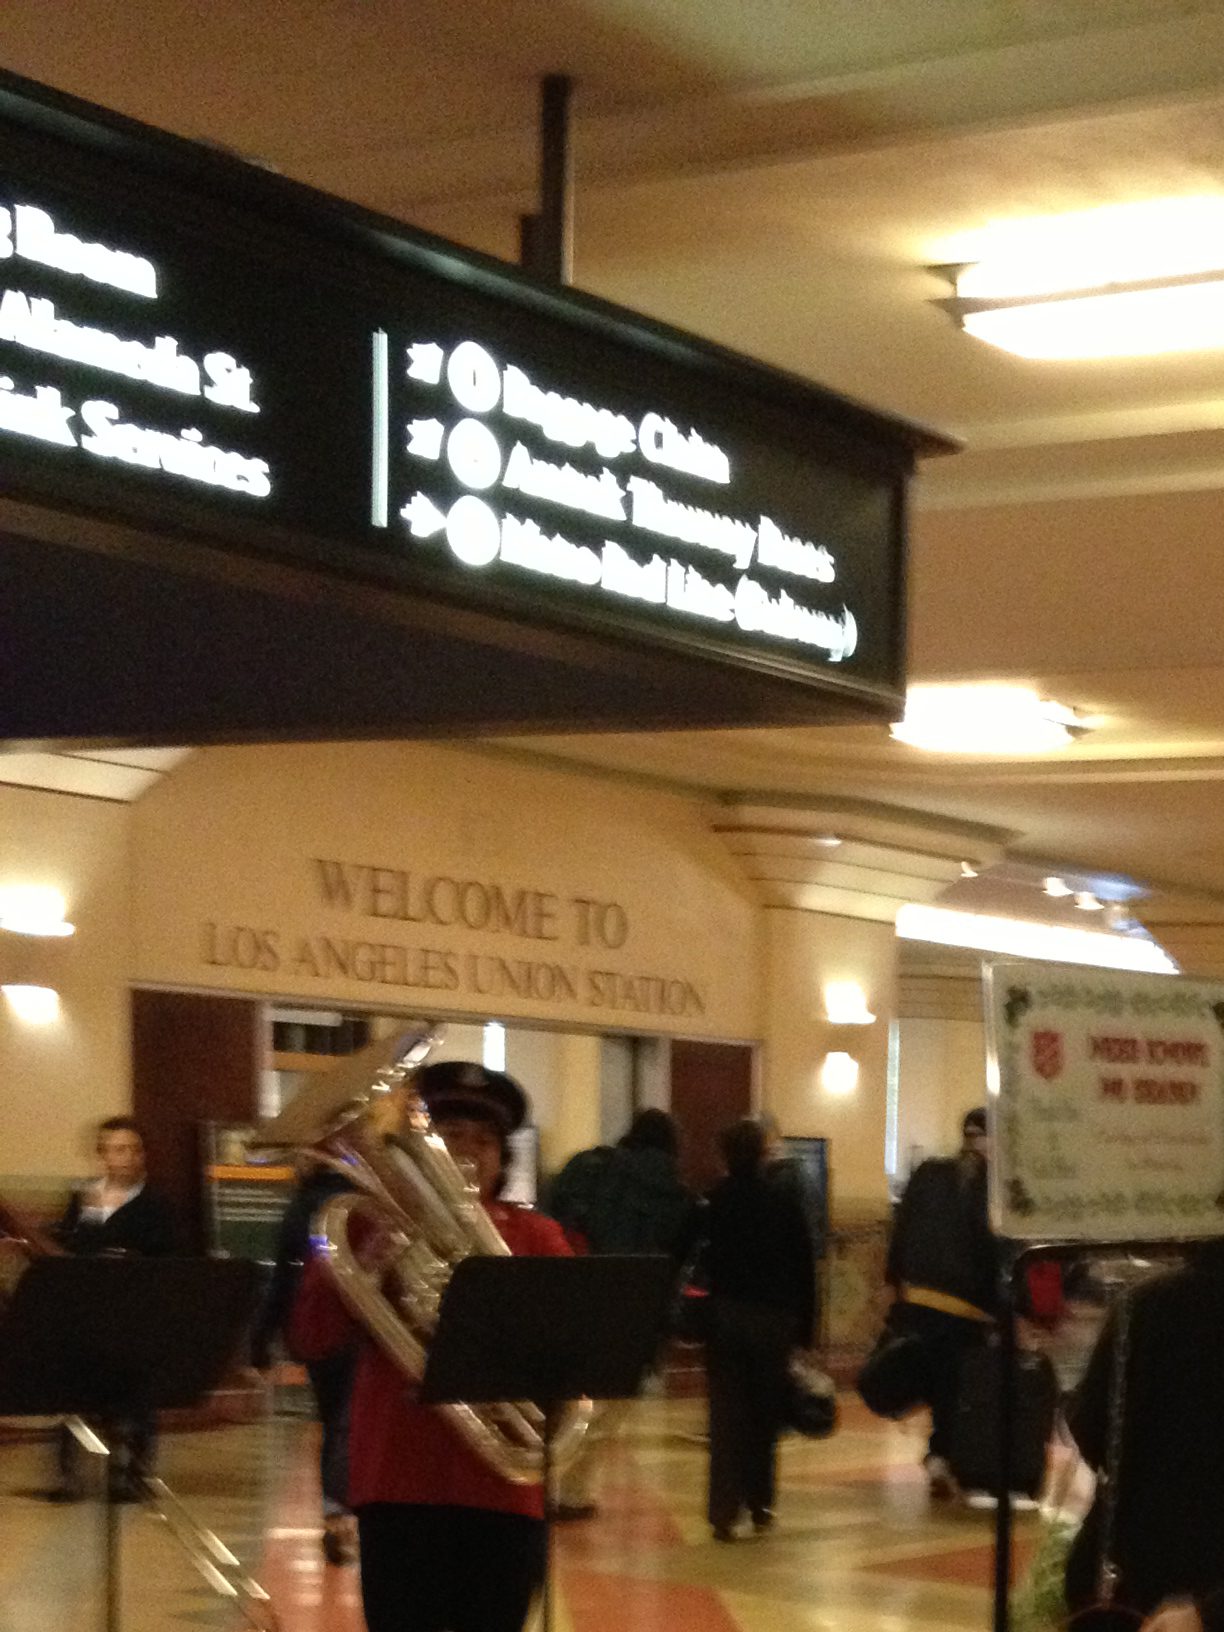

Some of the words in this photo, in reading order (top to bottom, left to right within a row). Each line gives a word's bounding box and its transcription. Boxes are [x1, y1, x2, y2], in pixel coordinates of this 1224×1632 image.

[309, 858, 558, 941] WELCOME
[570, 898, 629, 949] TO
[201, 921, 280, 972] LOS
[290, 935, 460, 992] ANGELES
[464, 952, 578, 1002] UNION
[588, 970, 707, 1018] STATION
